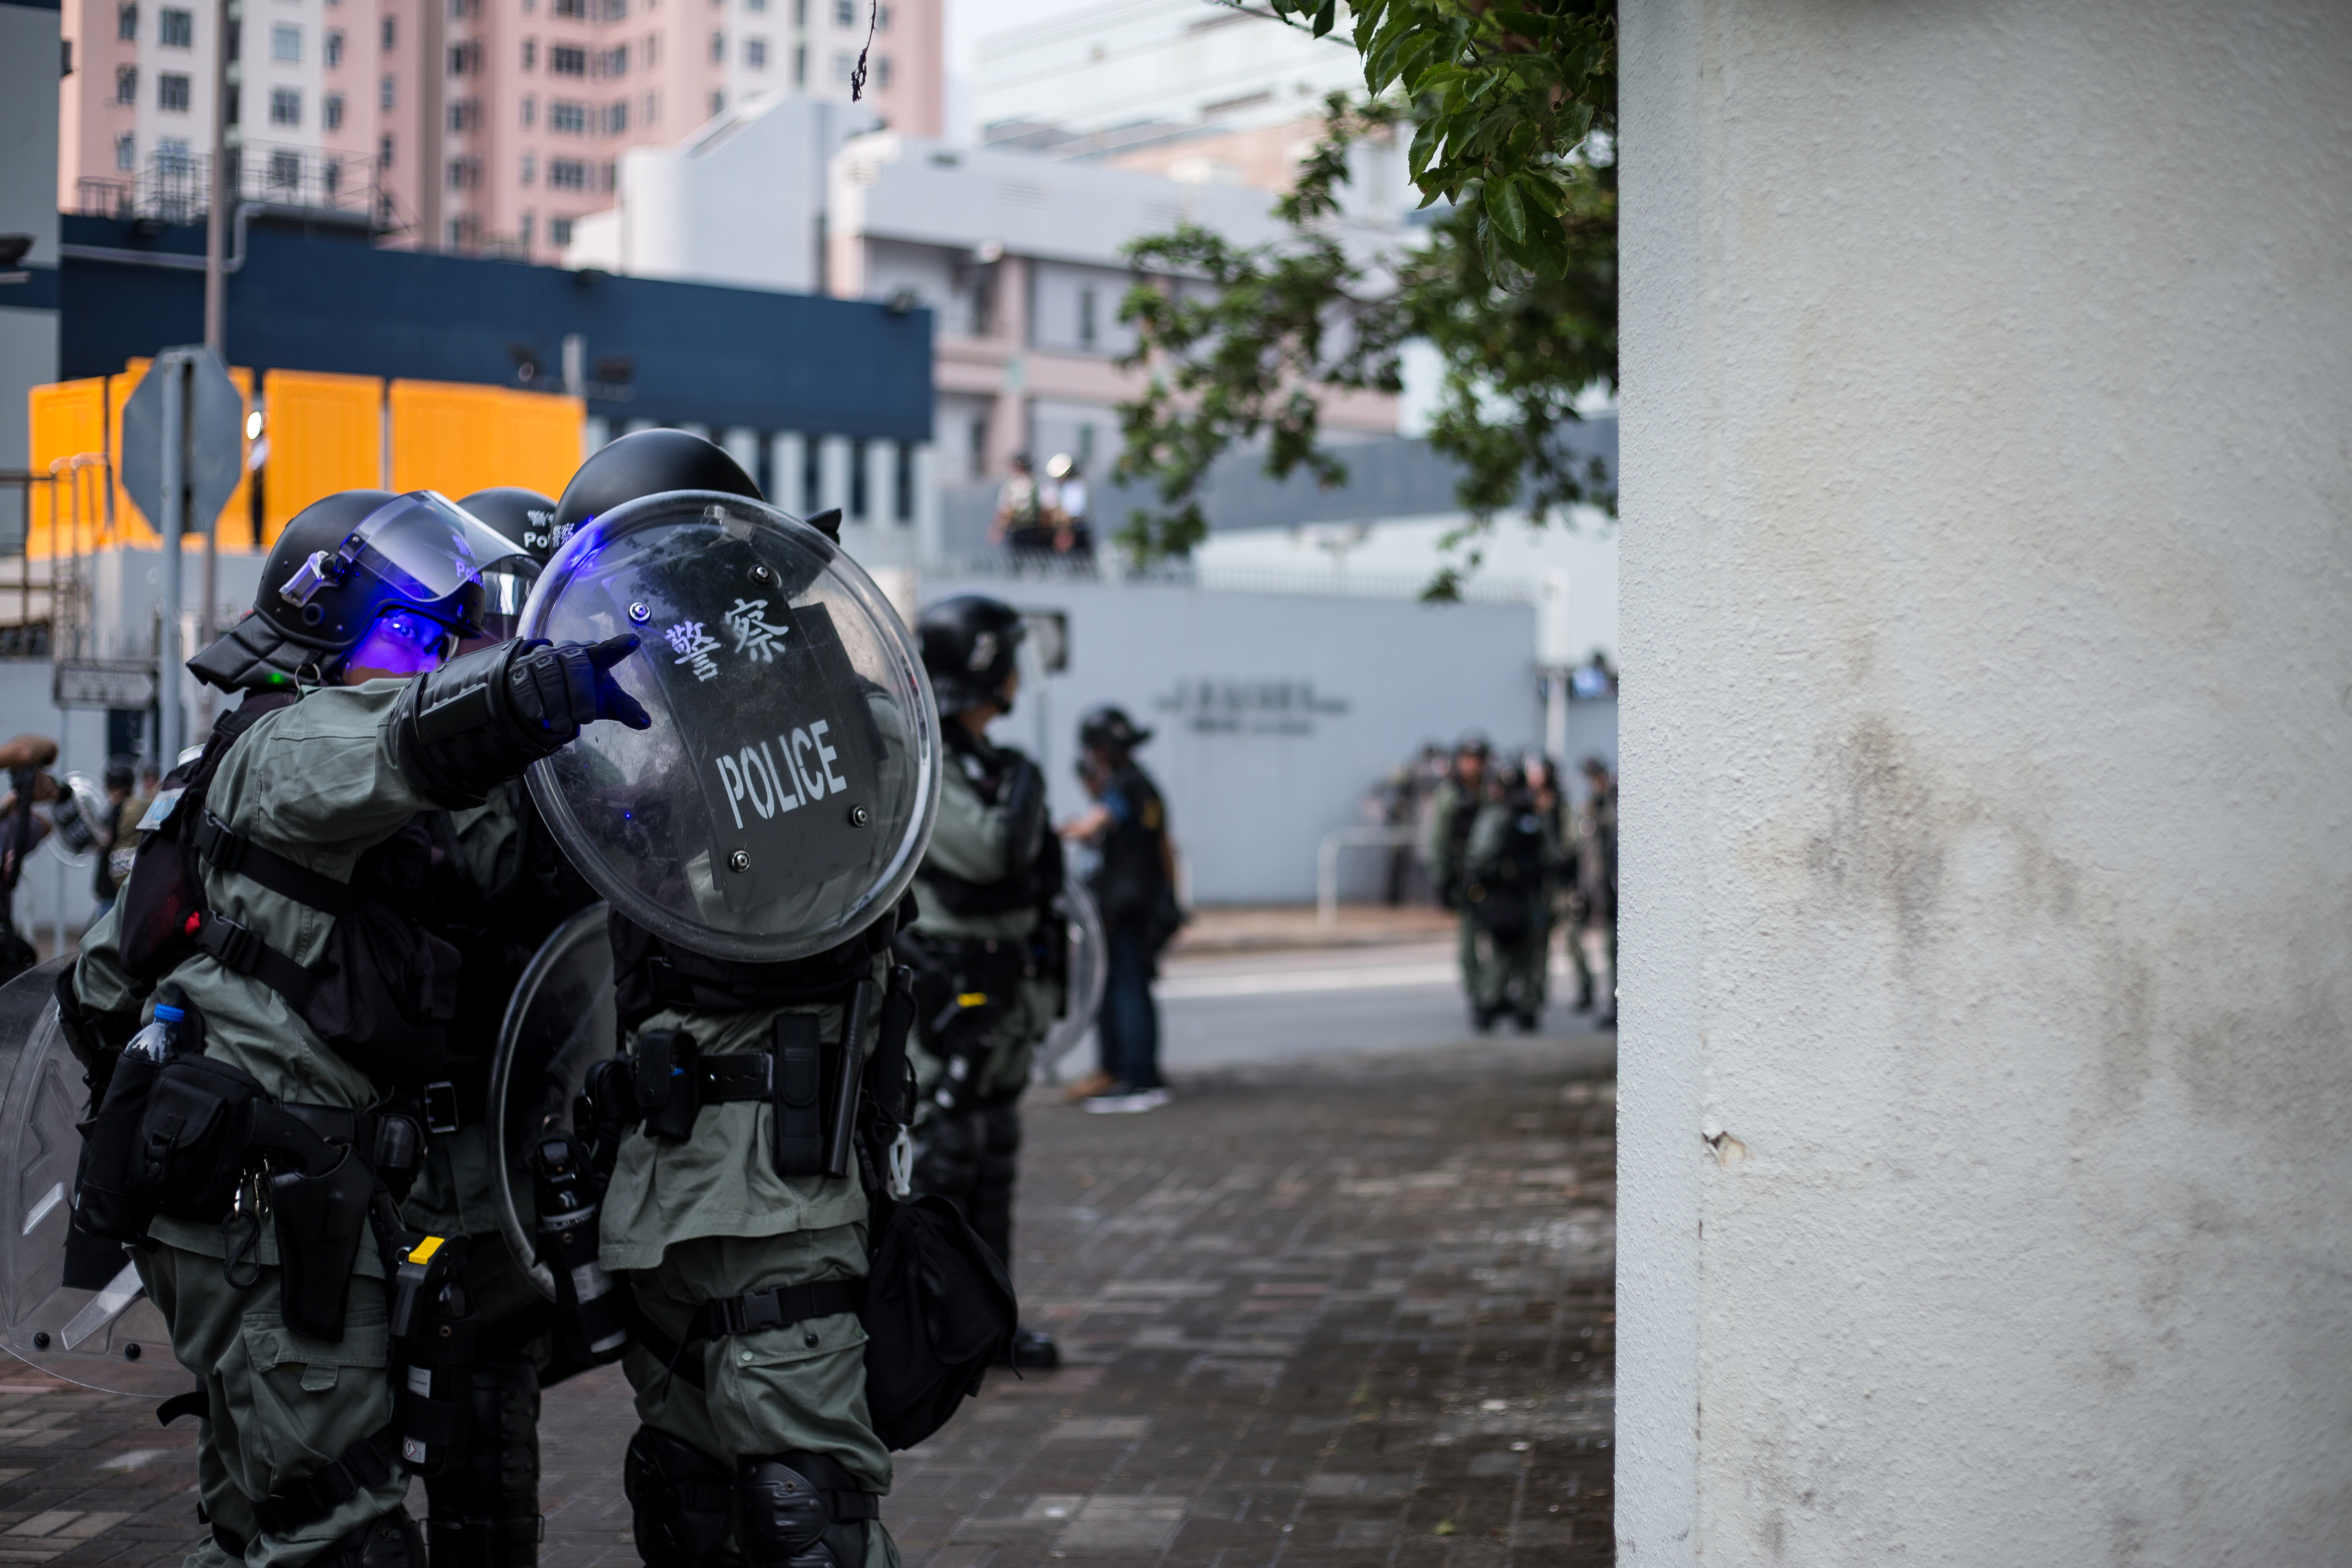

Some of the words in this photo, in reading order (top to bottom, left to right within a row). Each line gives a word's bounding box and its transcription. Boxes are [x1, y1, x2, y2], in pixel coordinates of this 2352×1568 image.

[524, 531, 551, 548] Po
[456, 561, 485, 590] Polic
[665, 599, 788, 682] 警察
[716, 719, 847, 829] POLICE
